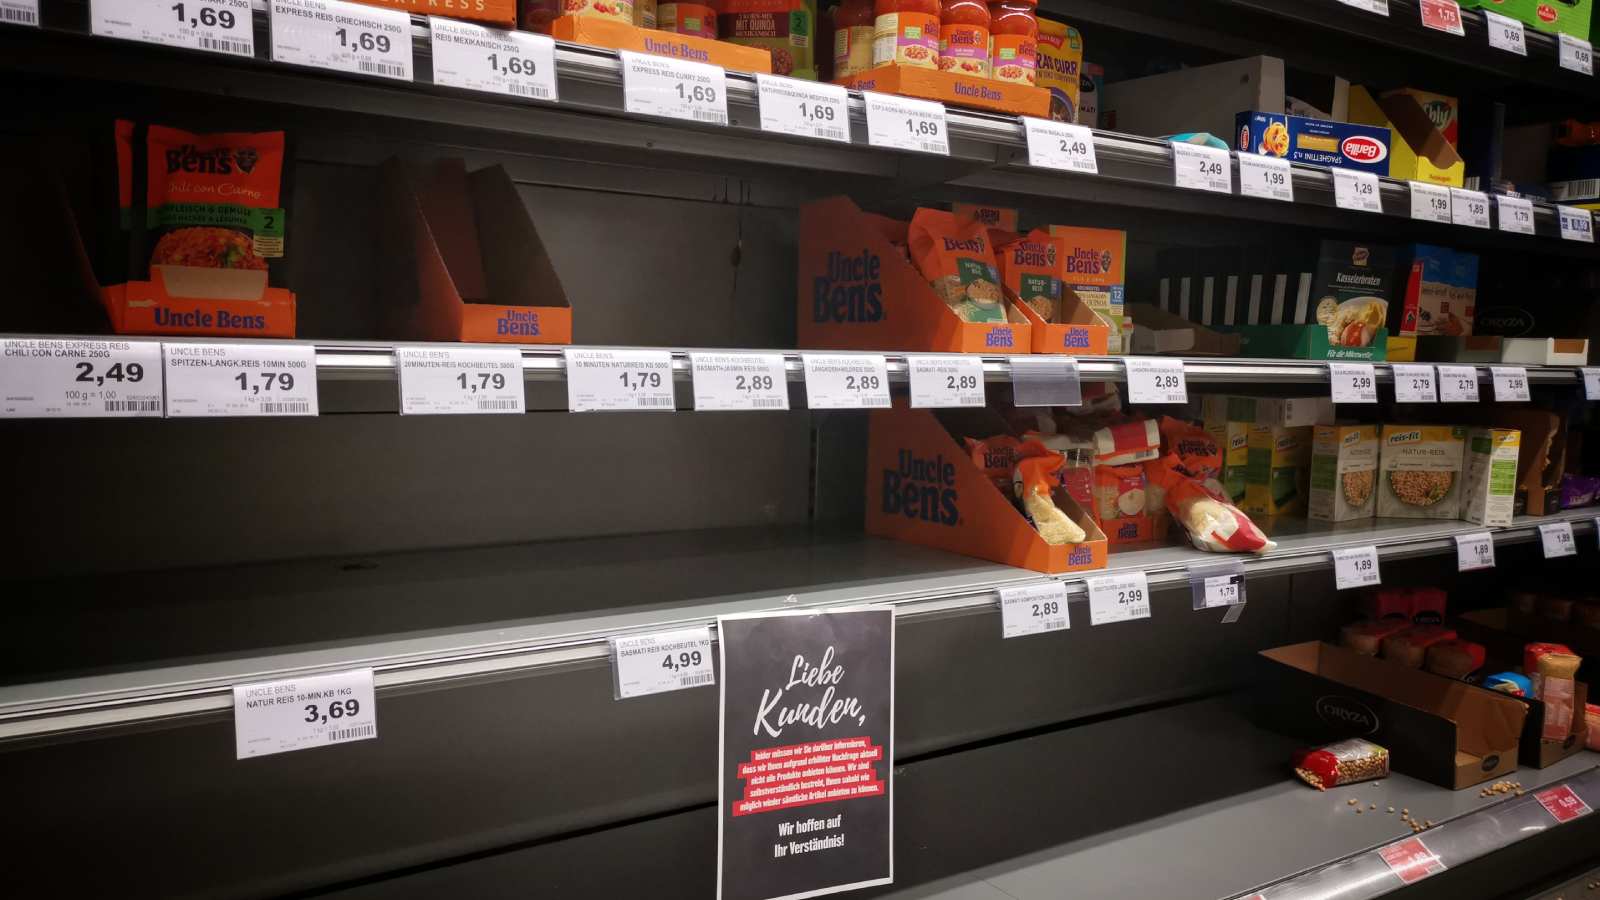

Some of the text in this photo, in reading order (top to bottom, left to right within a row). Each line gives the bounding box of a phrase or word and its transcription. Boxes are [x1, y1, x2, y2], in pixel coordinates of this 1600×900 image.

[171, 3, 236, 29] 1,69
[275, 5, 402, 33] EXPRESS REIS GRIECHISCH 250G
[434, 24, 458, 34] UNCLE
[335, 27, 391, 53] 1,69
[435, 33, 452, 43] REIS
[453, 36, 502, 50] MEXIKANISCH
[644, 37, 709, 61] Uncle Bens
[487, 53, 537, 77] 1,69
[632, 65, 660, 77] EXPRESS
[661, 69, 675, 78] REIS
[675, 71, 696, 82] CURRY
[675, 82, 717, 104] 1,69
[954, 81, 1003, 101] Uncle Bens
[798, 102, 835, 121] 1,69
[905, 118, 938, 137] 1,69
[1059, 139, 1087, 156] 2,49
[1345, 142, 1378, 158] Barilla
[1199, 160, 1223, 175] 2,49
[1263, 171, 1285, 186] 1,99
[1353, 182, 1373, 195] 1,29
[1430, 197, 1448, 210] 1,99
[1468, 202, 1484, 215] 1,89
[263, 215, 275, 229] 2
[1513, 210, 1529, 222] 1,79
[1014, 249, 1047, 267] Bens
[1074, 248, 1099, 262] Uncle
[829, 248, 881, 281] Uncle
[1066, 256, 1100, 274] Bens
[1335, 271, 1382, 287] Kasselerbraten
[814, 276, 883, 323] Bens
[1113, 291, 1123, 300] 12
[154, 308, 265, 329] Uncle Bens
[507, 310, 539, 322] Uncle
[496, 317, 541, 337] Bens
[992, 327, 1013, 337] Uncle
[1069, 327, 1089, 337] Uncle
[5, 340, 130, 351] UNCLE BENS EXPRESS REIS
[986, 332, 1014, 347] Bens
[1063, 332, 1089, 347] Bens
[54, 350, 87, 358] CARNE
[88, 350, 111, 358] 250G
[170, 348, 226, 357] UNCLE BENS
[403, 351, 428, 359] UNCLE
[171, 358, 307, 368] SPITZEN-LANGK.REIS 10MIN 500G
[75, 361, 144, 387] 2,49
[456, 372, 506, 393] 1,79
[619, 371, 662, 392] 1,79
[1154, 375, 1179, 390] 2,89
[234, 371, 295, 395] 1,79
[735, 375, 773, 393] 2,89
[846, 375, 880, 393] 2,89
[946, 375, 977, 392] 2,89
[1352, 377, 1372, 390] 2,99
[1412, 378, 1430, 391] 2,79
[1458, 379, 1474, 391] 2,79
[1507, 379, 1524, 391] 2,99
[65, 390, 80, 400] 100
[82, 392, 88, 401] g
[98, 390, 117, 401] 1,00
[1390, 430, 1420, 443] reis-fit
[1402, 447, 1446, 457] NATUR-REIS
[898, 449, 956, 486] Uncle
[883, 469, 960, 528] Bens
[1556, 532, 1571, 544] 1,89
[1074, 545, 1092, 555] Uncle
[1473, 544, 1489, 556] 1,89
[1068, 552, 1093, 566] Bens
[1353, 559, 1372, 573] 1,89
[1117, 589, 1142, 606] 2,99
[1219, 587, 1235, 598] 1,79
[1032, 601, 1059, 617] 2,89
[661, 650, 703, 673] 4,99
[785, 646, 845, 691] Liebe
[245, 684, 297, 698] UNCLE BENS
[246, 698, 275, 709] NATUR
[276, 695, 295, 705] REIS
[336, 687, 352, 696] 1KG
[303, 698, 360, 725] 3,69
[753, 686, 867, 738] Kunden,
[1323, 703, 1370, 727] ORYZA
[794, 747, 803, 756] wir
[803, 745, 812, 754] Sie
[742, 765, 757, 775] dass
[757, 763, 767, 773] wir
[767, 761, 783, 770] Ihnen
[783, 758, 808, 769] aufgrund
[831, 752, 859, 762] Nachfrage
[859, 749, 878, 759] aktuell
[751, 761, 870, 785] nicht alle Produkte anbieten können. Wir sind
[750, 781, 801, 797] selbstverständlich
[826, 776, 842, 786] Ihnen
[860, 773, 870, 782] wie
[740, 784, 880, 812] möglich wieder sämtliche Artikel anbieten zu können.
[778, 814, 842, 837] Wir hoffen auf
[774, 833, 845, 858] Ihr Verständnis!
